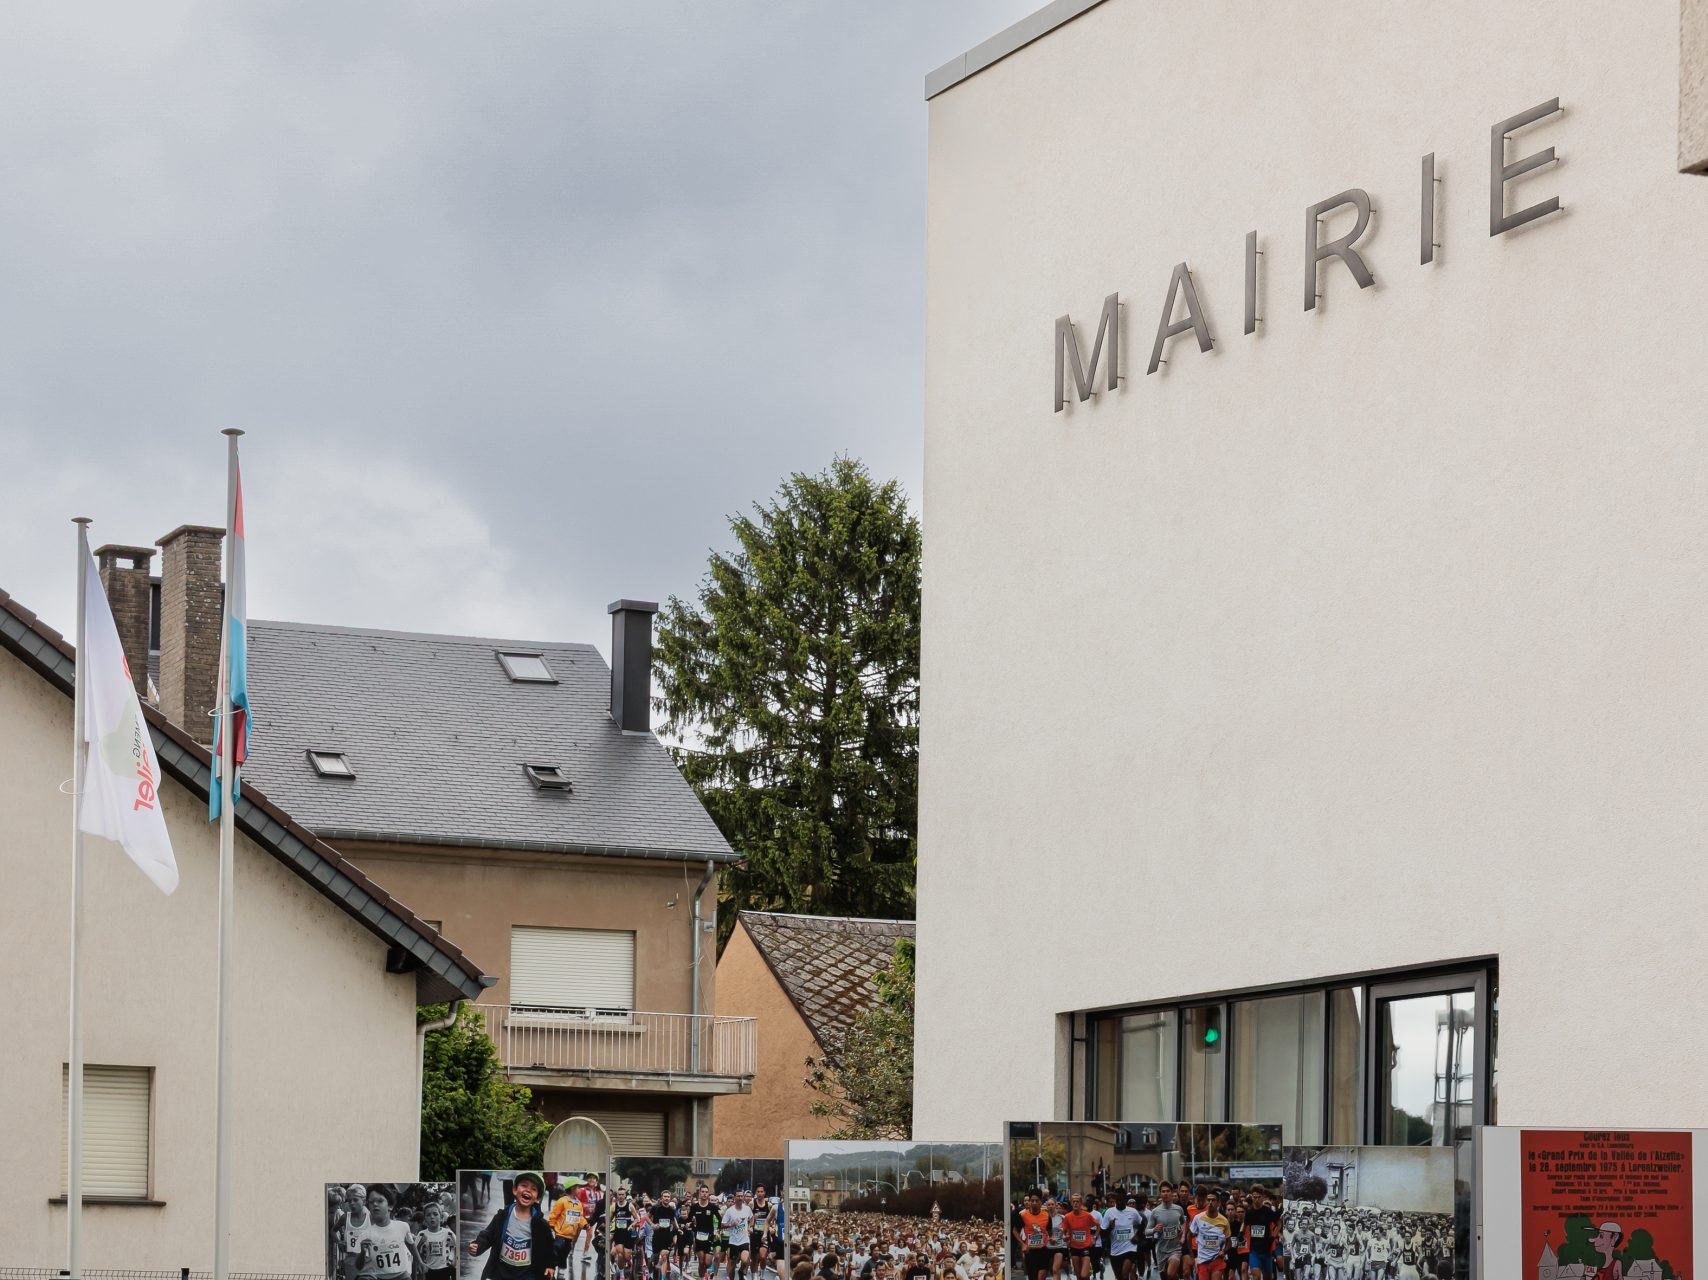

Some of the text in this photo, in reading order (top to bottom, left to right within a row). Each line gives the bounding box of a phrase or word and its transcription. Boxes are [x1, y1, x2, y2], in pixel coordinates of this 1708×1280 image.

[1054, 96, 1560, 413] MAIRIE
[1528, 1151, 1536, 1161] le
[1568, 1151, 1584, 1161] Prix
[1588, 1151, 1597, 1161] de
[1600, 1151, 1608, 1161] la
[1637, 1151, 1647, 1161] de
[1529, 1163, 1536, 1172] le
[1555, 1163, 1597, 1174] septembre
[1599, 1162, 1618, 1172] 1975
[376, 1252, 401, 1269] 614
[504, 1246, 527, 1261] 7350
